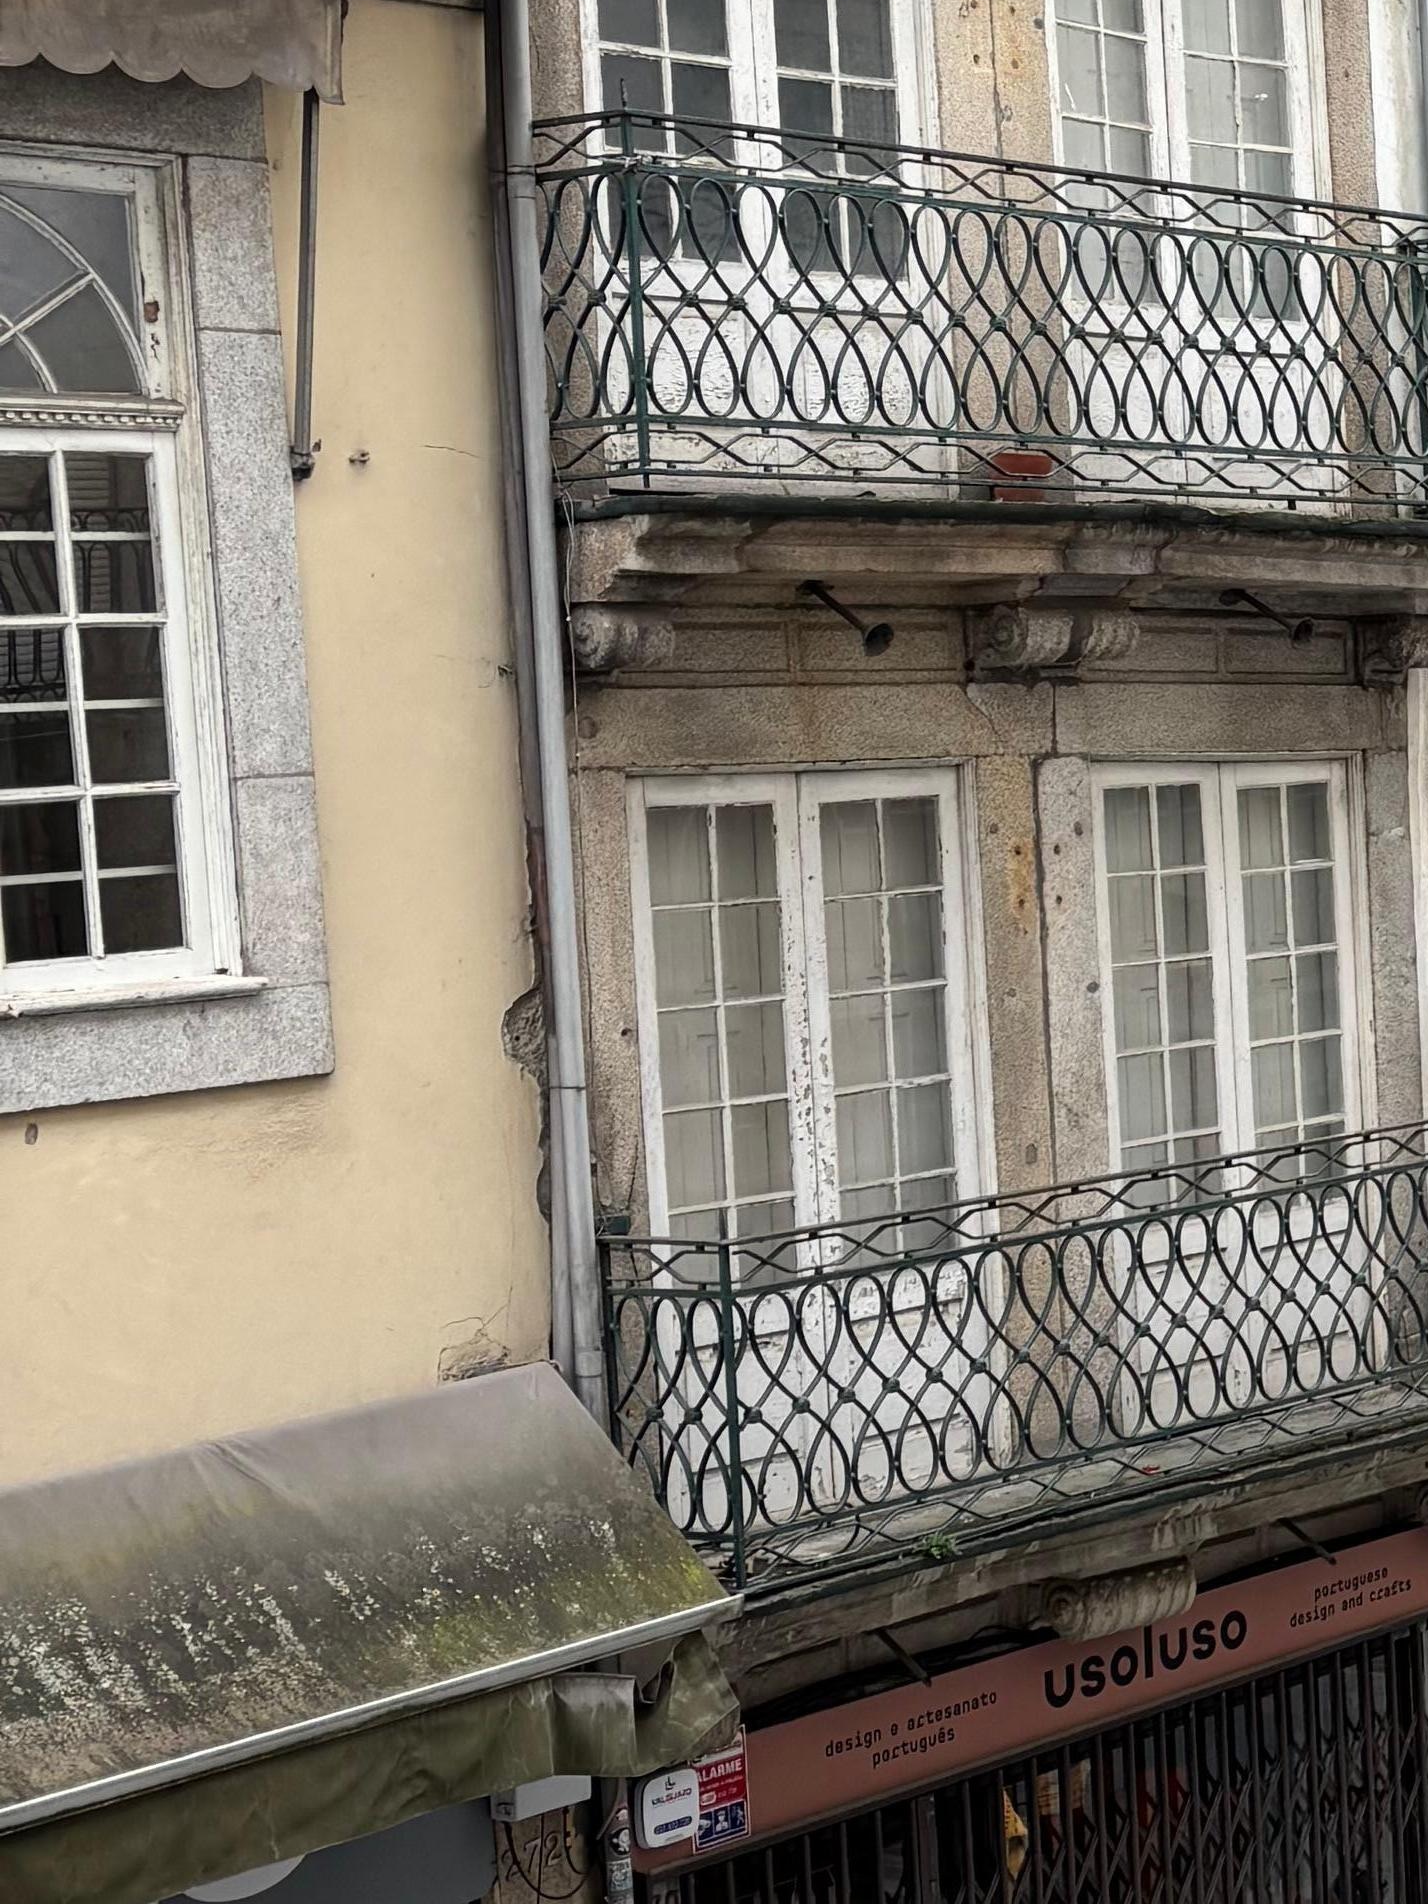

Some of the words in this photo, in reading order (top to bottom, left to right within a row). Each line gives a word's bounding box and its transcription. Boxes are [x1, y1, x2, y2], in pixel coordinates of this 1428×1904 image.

[1289, 1603, 1336, 1629] design
[1341, 1592, 1364, 1612] and
[1369, 1579, 1412, 1603] crafts
[1313, 1567, 1389, 1602] portuguese
[1044, 1609, 1248, 1709] usoluso
[825, 1728, 882, 1757] design
[890, 1723, 899, 1737] e
[907, 1691, 997, 1731] artesanato
[872, 1727, 956, 1770] português
